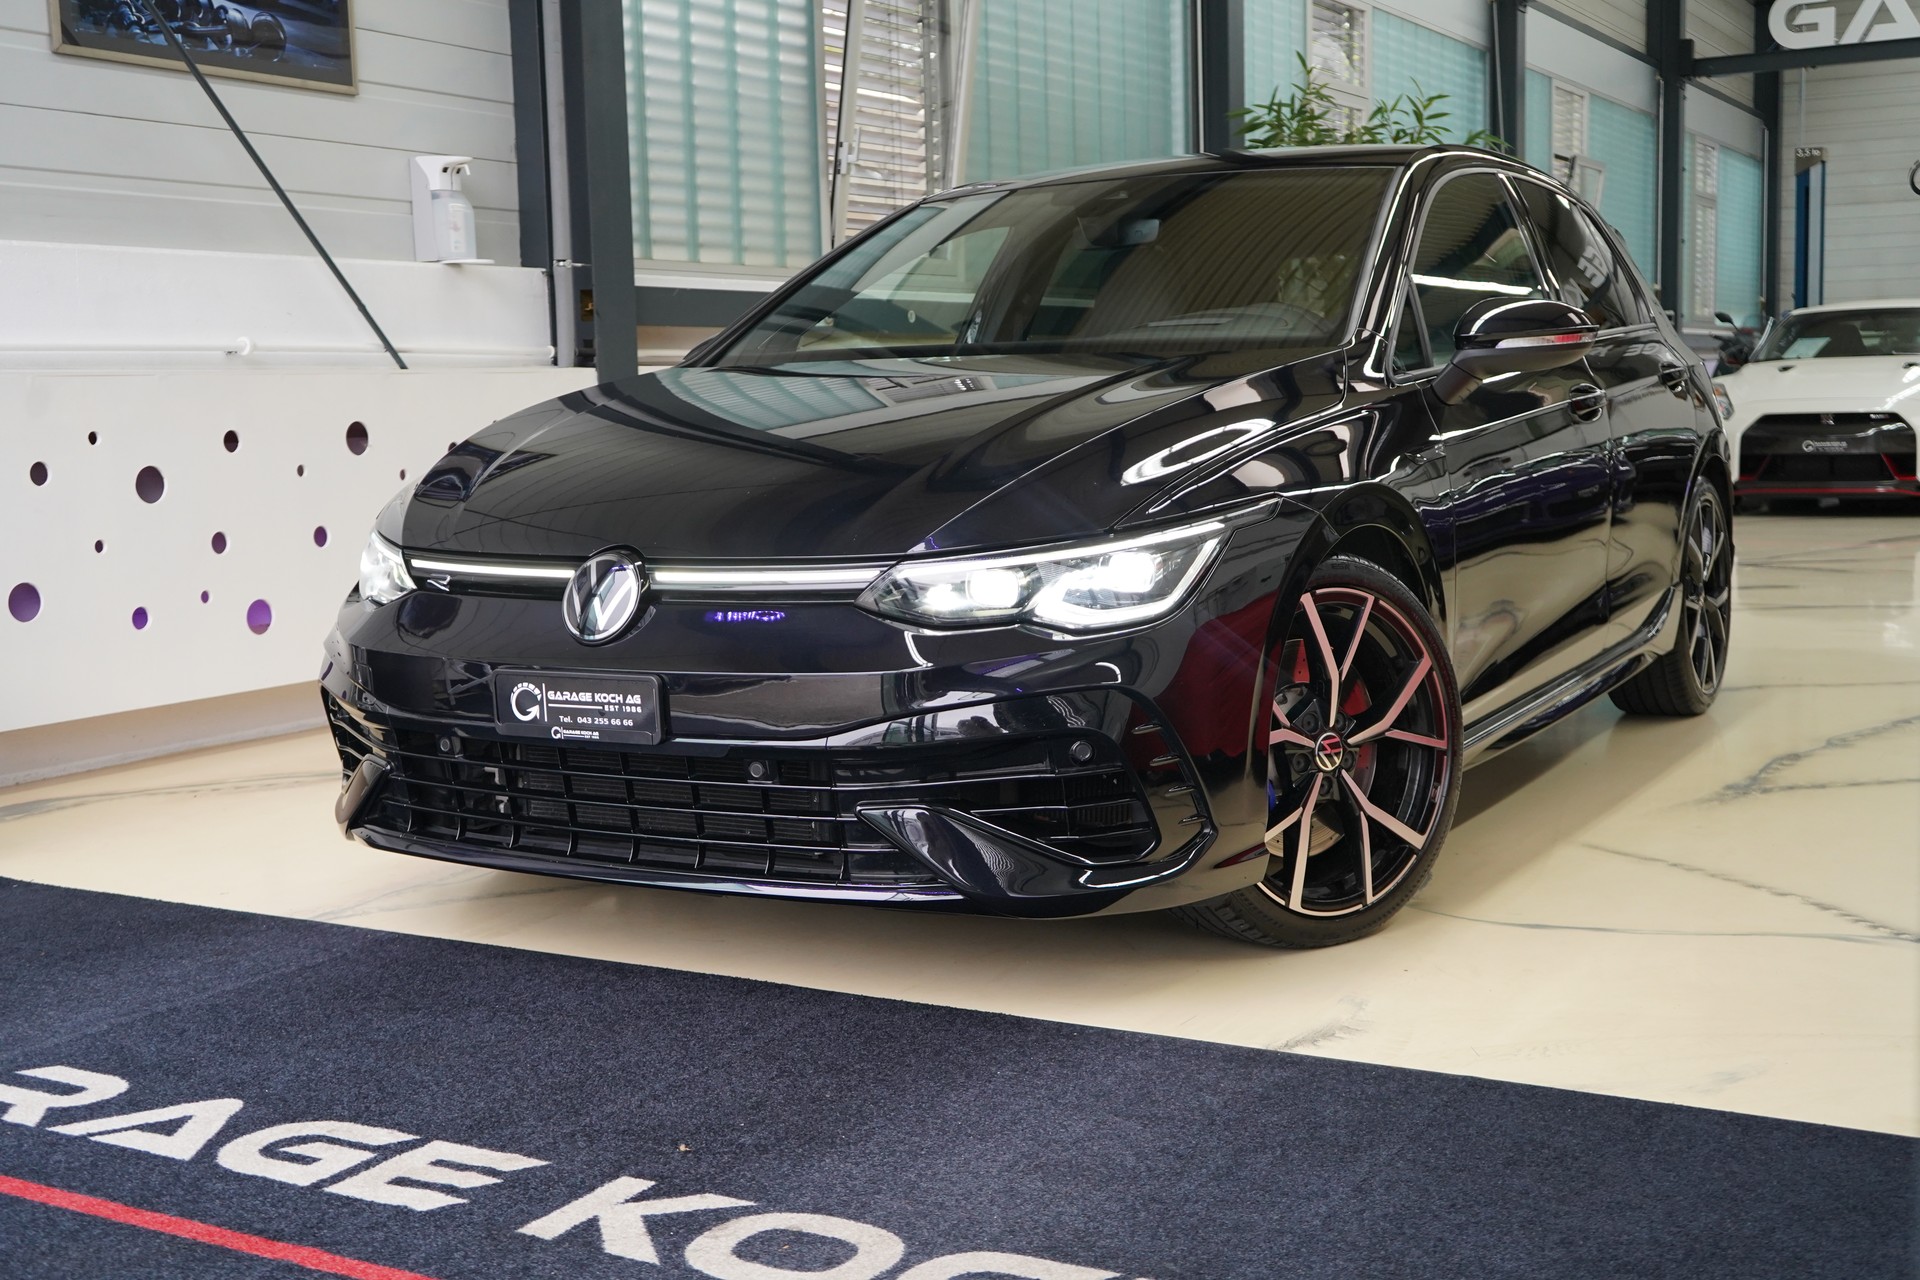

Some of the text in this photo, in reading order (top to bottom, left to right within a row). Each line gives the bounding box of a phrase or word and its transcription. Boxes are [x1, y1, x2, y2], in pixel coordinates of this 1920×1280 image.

[547, 690, 642, 705] GARAGE KOCH AG
[622, 705, 642, 713] 1986
[559, 715, 634, 727] Tel. 043 255 66 66
[0, 1065, 552, 1212] RAGE
